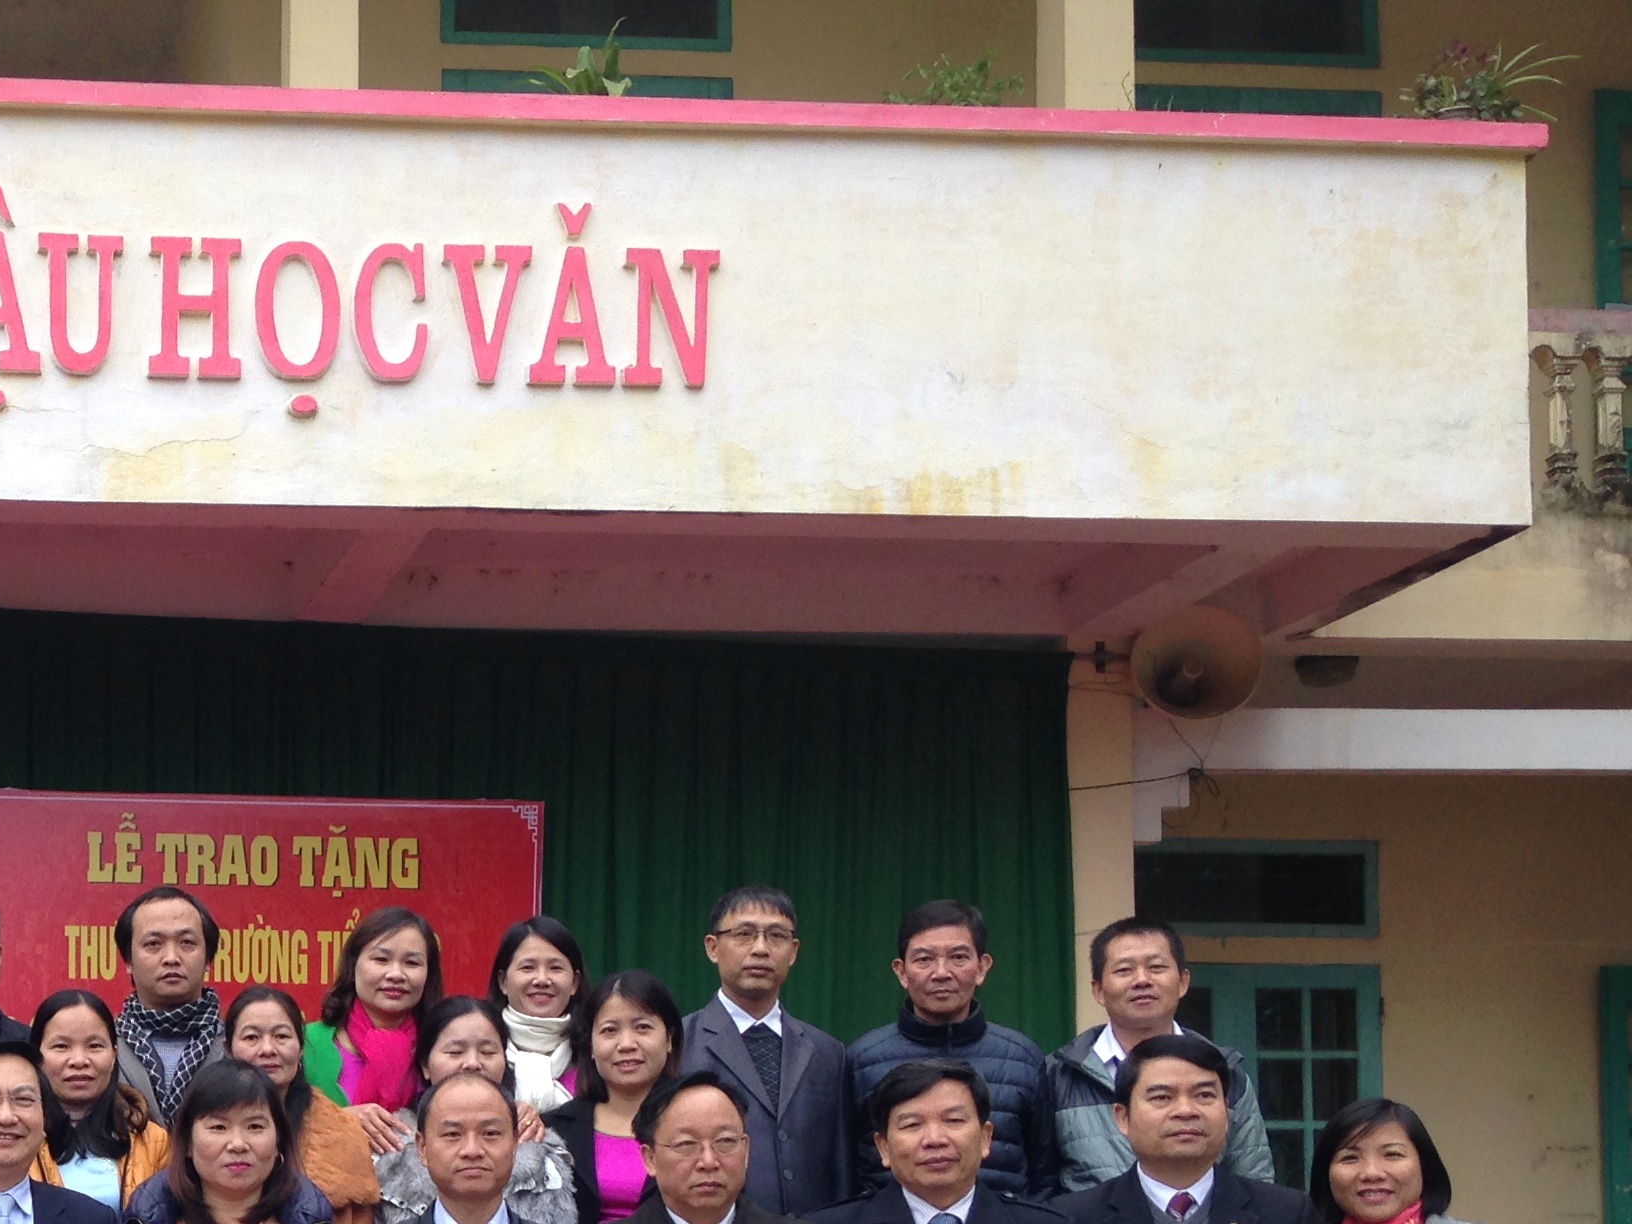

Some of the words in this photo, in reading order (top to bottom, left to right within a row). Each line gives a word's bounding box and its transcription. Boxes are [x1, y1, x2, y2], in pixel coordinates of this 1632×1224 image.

[148, 236, 429, 418] HỌC
[442, 202, 721, 389] VĂN
[86, 811, 143, 884] LỄ
[155, 832, 280, 887] TRAO
[292, 824, 421, 899] TẶNG
[203, 914, 309, 985] RƯỜNG
